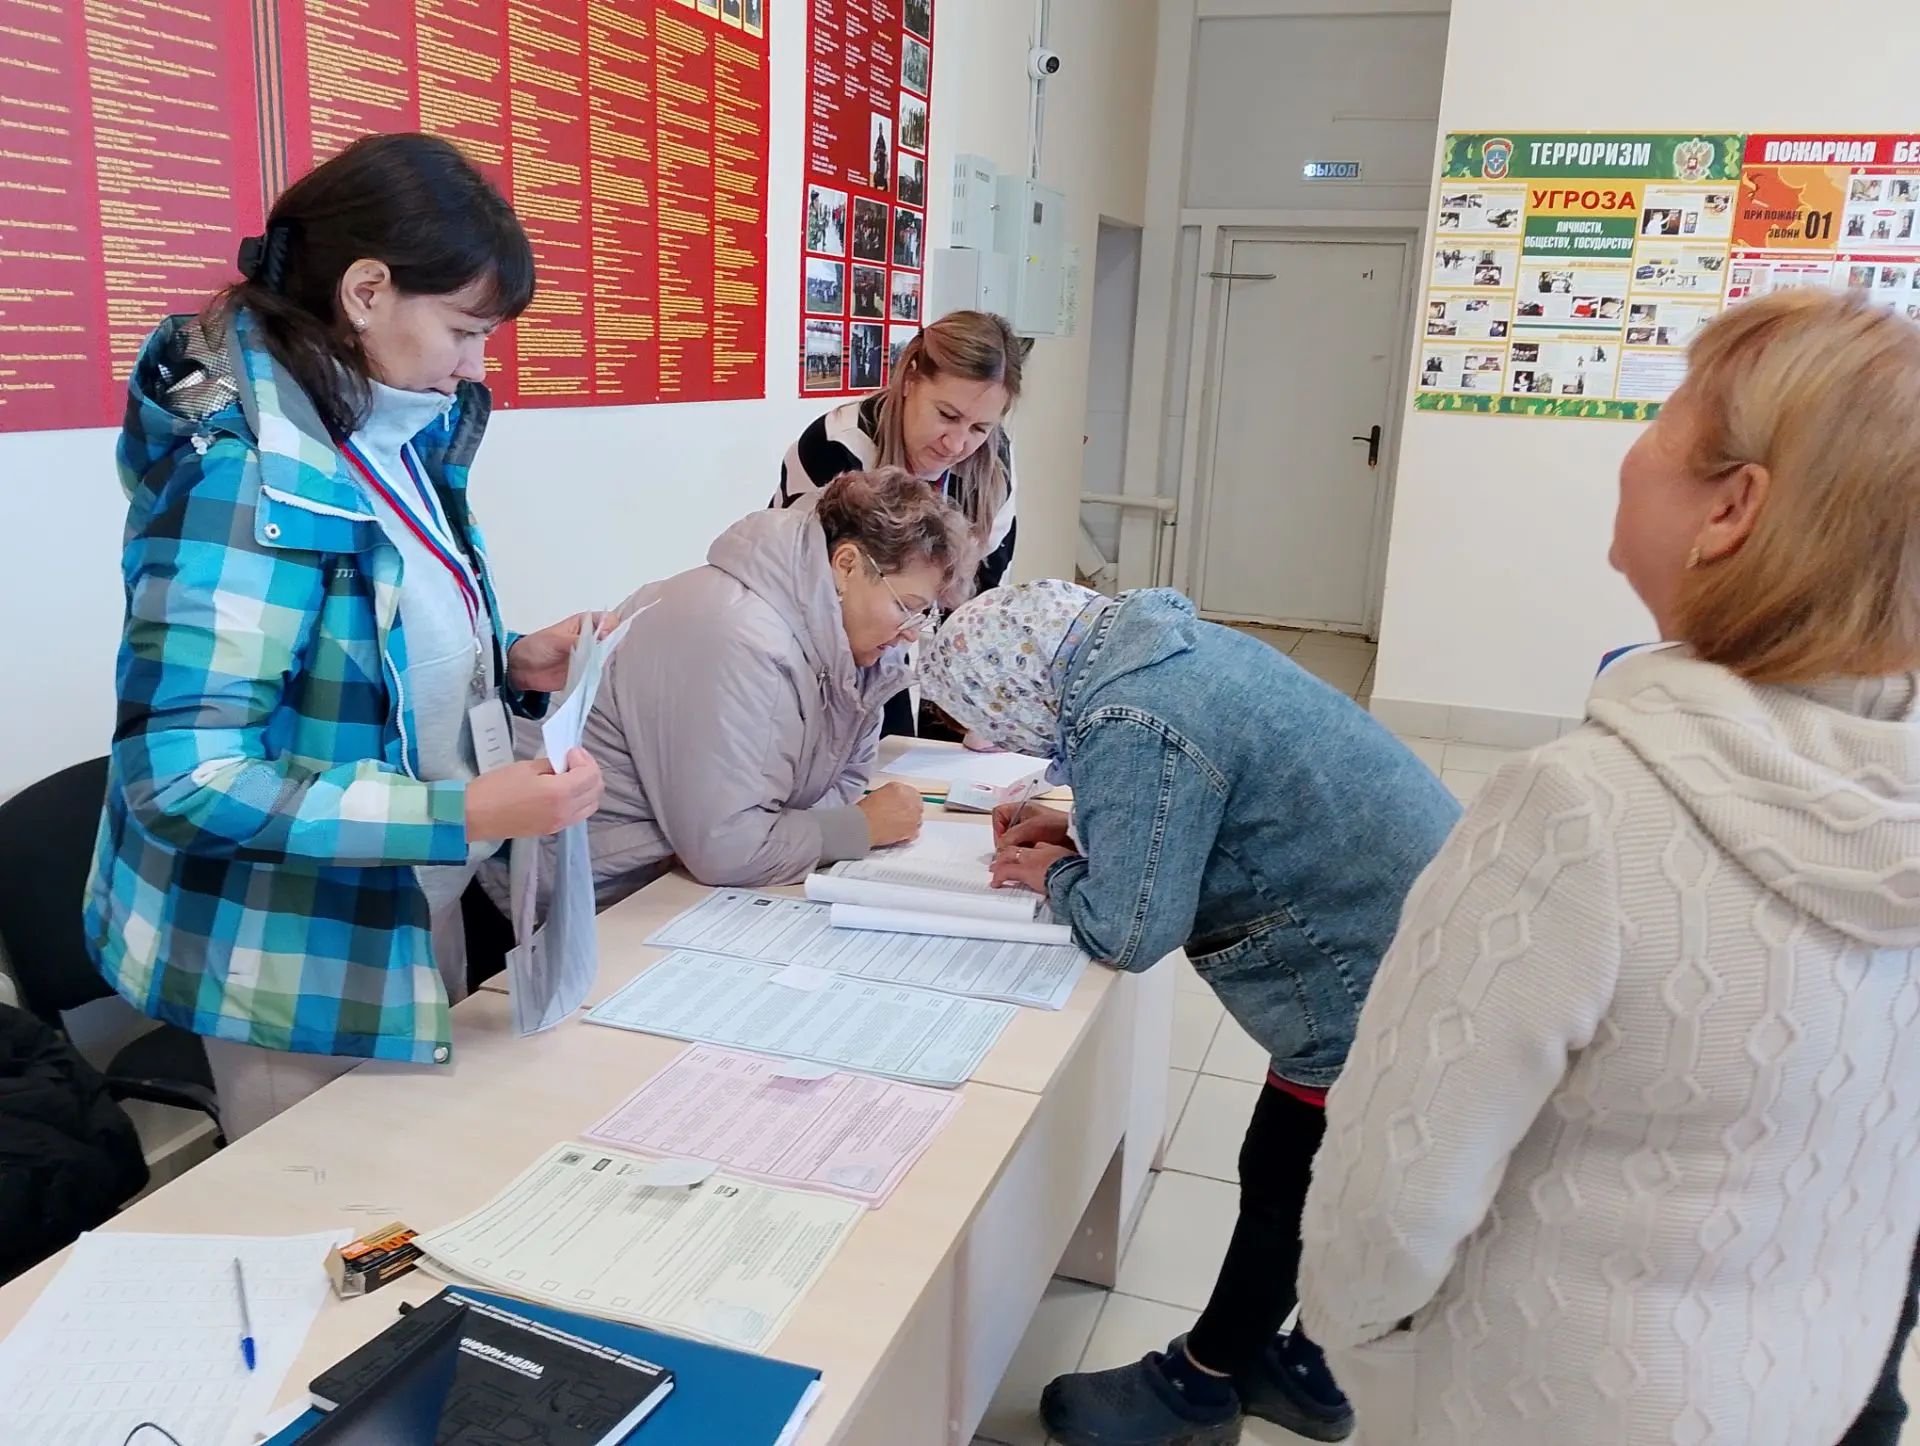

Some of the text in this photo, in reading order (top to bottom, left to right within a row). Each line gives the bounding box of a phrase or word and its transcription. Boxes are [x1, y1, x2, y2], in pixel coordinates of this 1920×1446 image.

[1530, 142, 1652, 166] ТЕРРОРИЗМ
[1764, 141, 1877, 163] ПОЖАРНАЯ
[1304, 163, 1357, 177] ВЫХОД
[1531, 190, 1636, 210] УГРОЗА
[1743, 209, 1763, 220] ПРИ
[1556, 220, 1604, 235] ЛИЧНОСТИ,
[1805, 211, 1833, 239] 01
[1523, 236, 1572, 250] ОБЩЕСТВУ,
[1573, 236, 1634, 251] ГОСУДАРСТВУ
